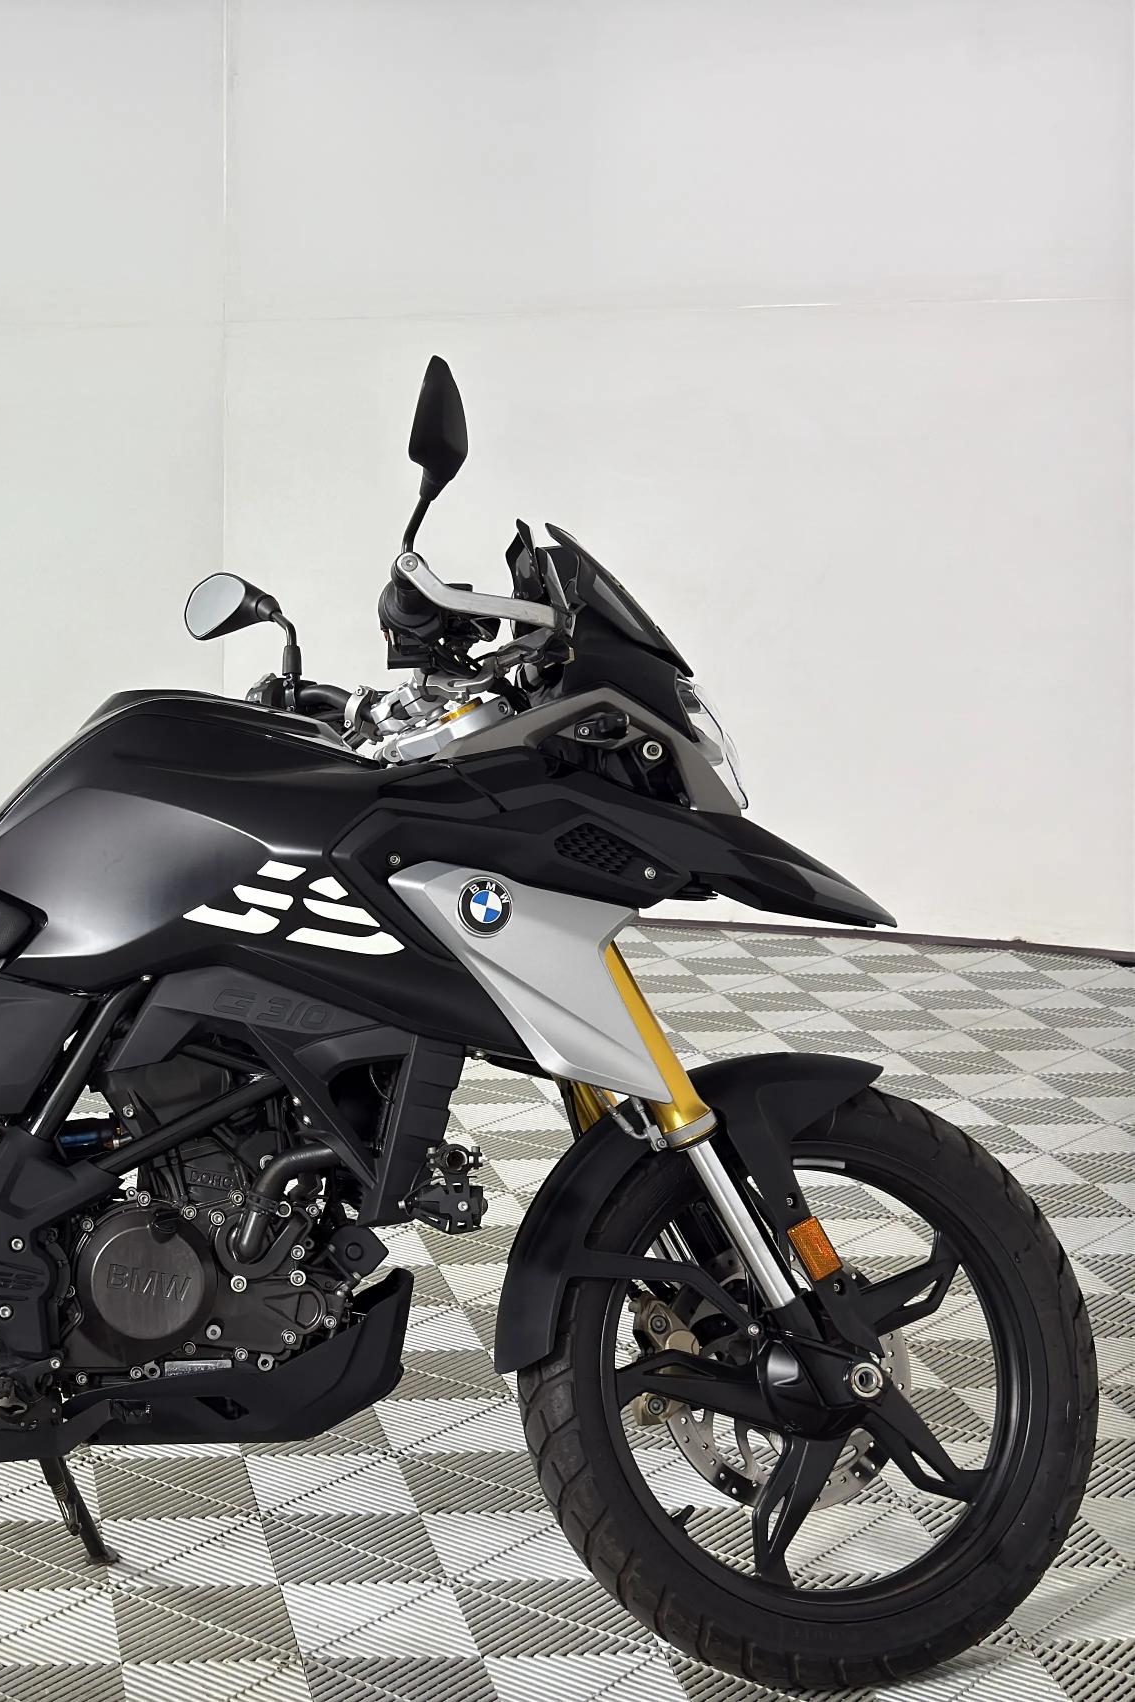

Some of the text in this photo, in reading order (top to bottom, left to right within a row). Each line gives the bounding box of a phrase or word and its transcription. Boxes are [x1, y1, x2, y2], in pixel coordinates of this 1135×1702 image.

[212, 987, 334, 1030] G 310
[190, 1170, 235, 1189] DOHC
[106, 1263, 192, 1304] BMW
